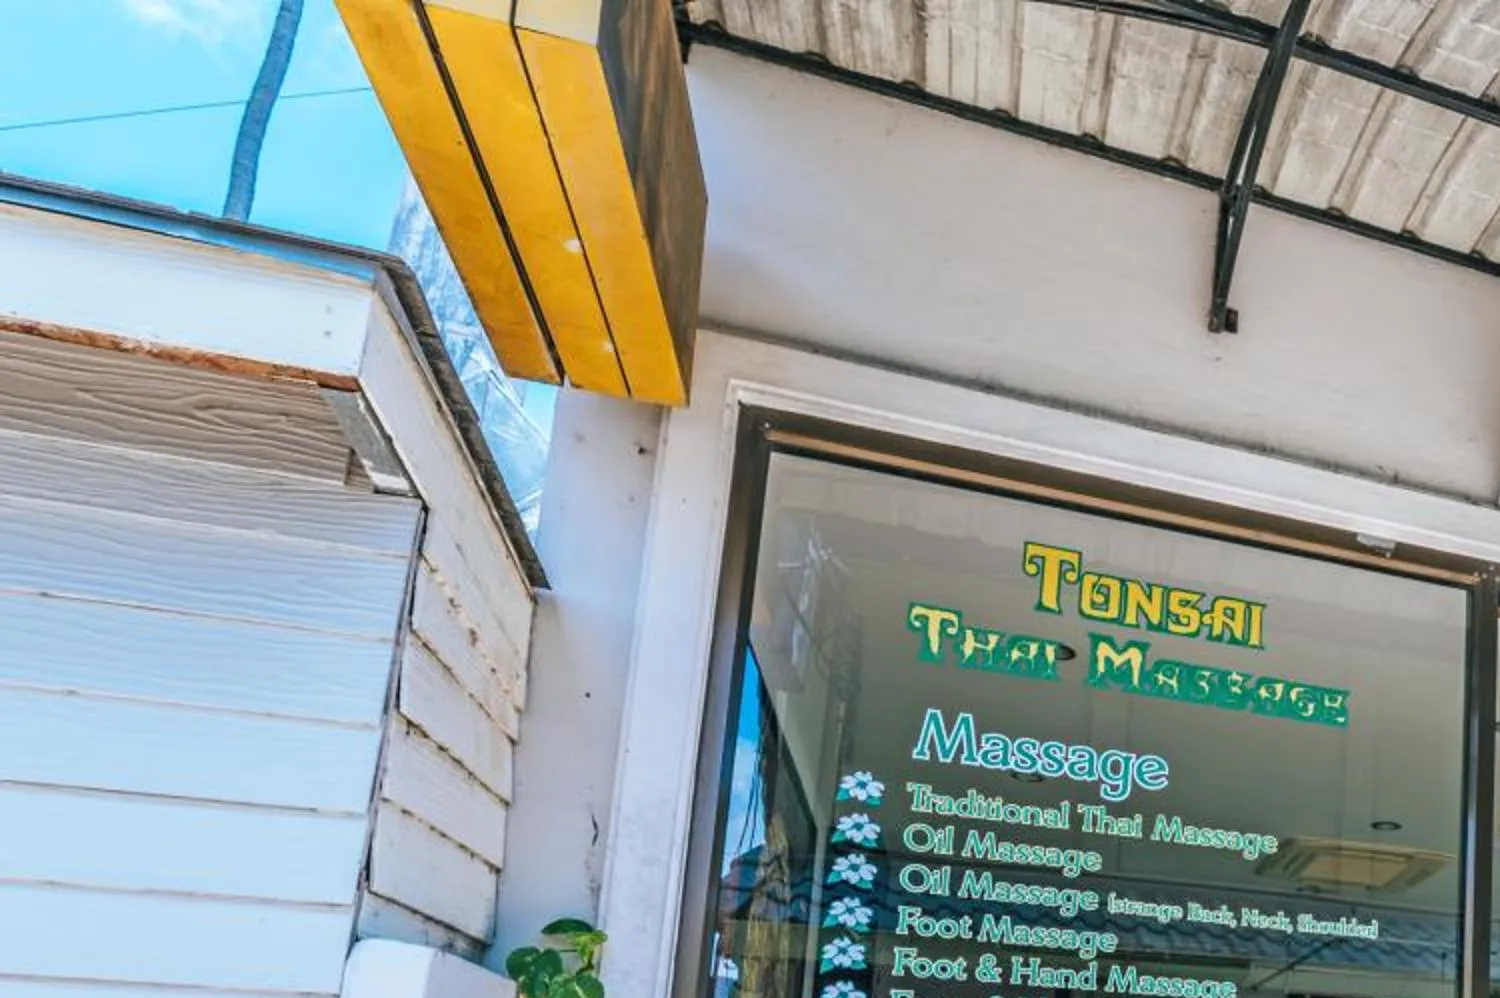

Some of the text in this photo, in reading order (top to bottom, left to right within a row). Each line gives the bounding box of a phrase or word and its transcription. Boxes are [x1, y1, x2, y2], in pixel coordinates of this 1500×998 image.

[912, 708, 1169, 801] Massage
[906, 781, 1278, 860] Traditional Thai Massage
[903, 823, 1102, 878] Oil Massage
[900, 863, 950, 897] Oil
[958, 870, 1099, 917] Massage
[896, 906, 1118, 959] Foot Massage
[892, 947, 967, 980] Foot
[975, 954, 1002, 983] &
[1010, 956, 1097, 991] Hand
